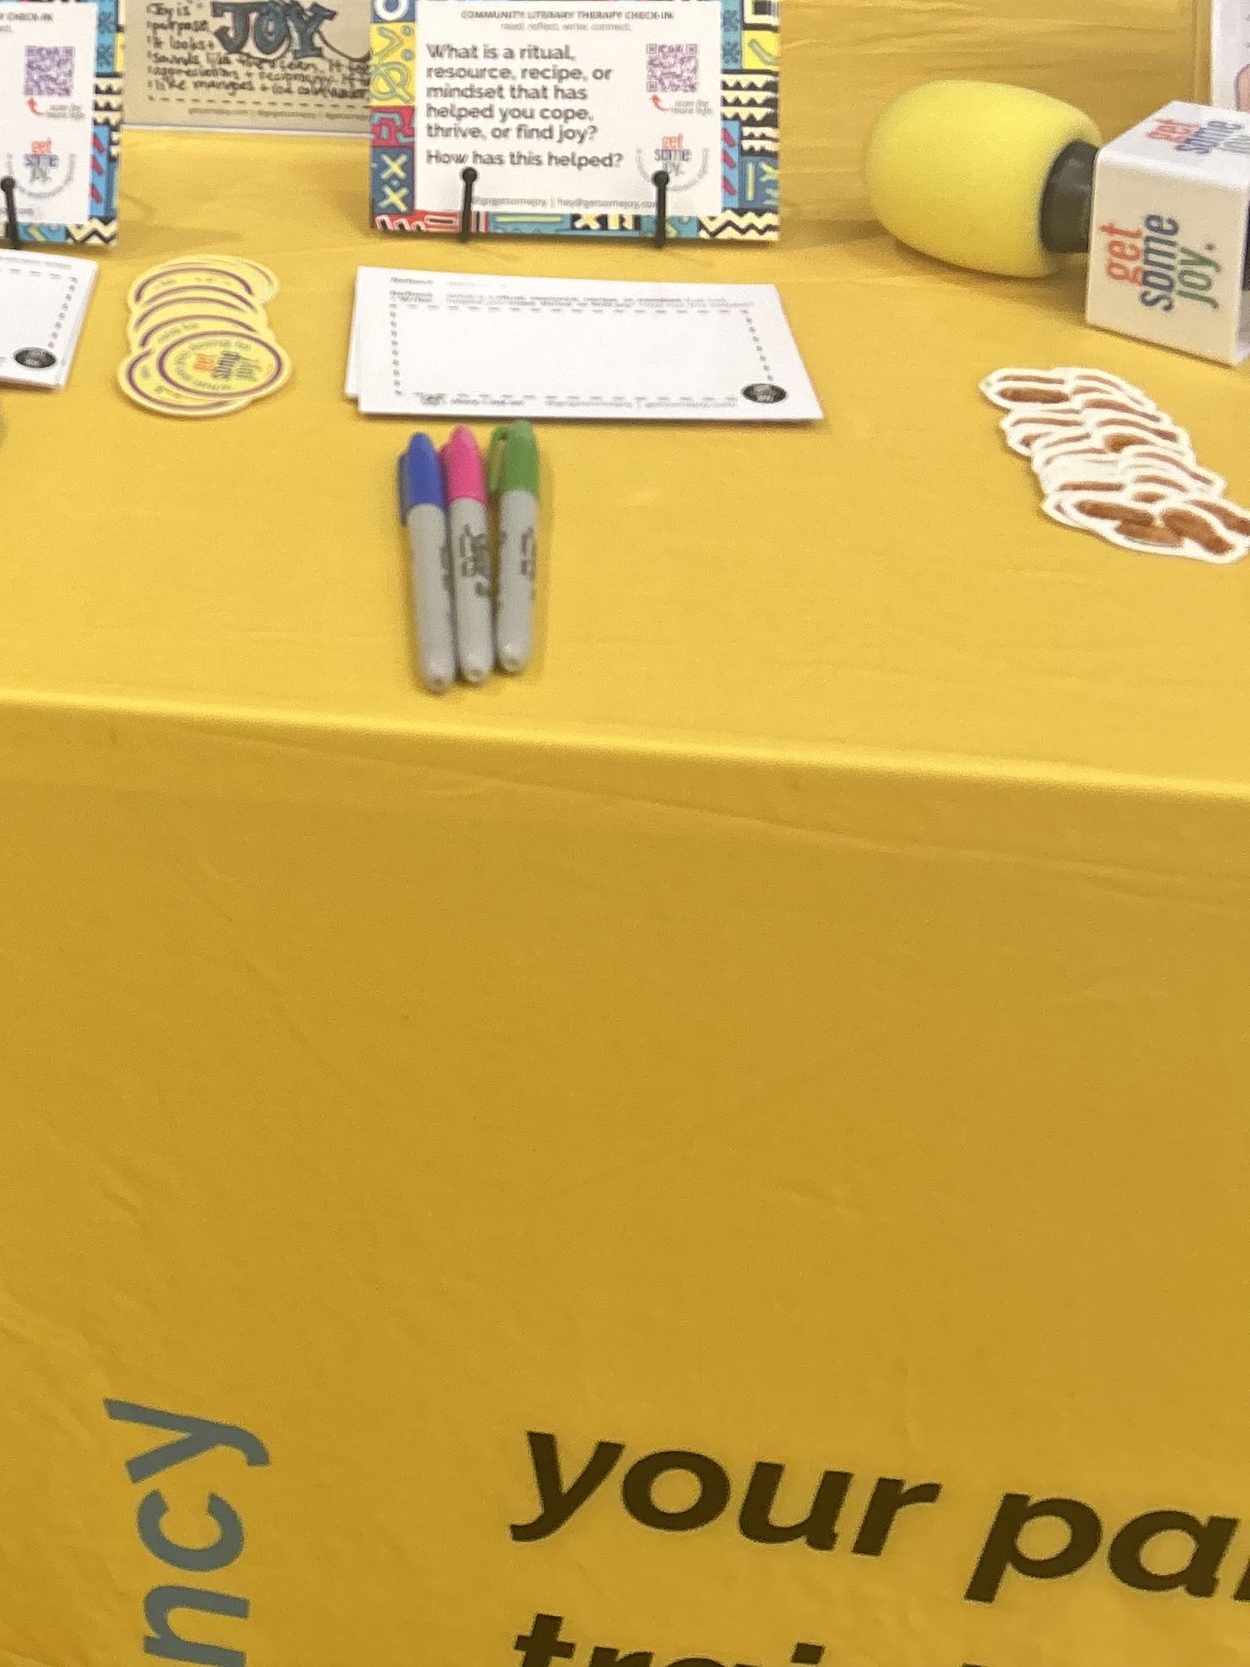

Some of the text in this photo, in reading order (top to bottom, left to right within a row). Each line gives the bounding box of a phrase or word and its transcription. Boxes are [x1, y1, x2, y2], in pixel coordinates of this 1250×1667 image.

[426, 43, 576, 61] What is a ritual,
[426, 65, 614, 84] resource, recipe, or
[426, 85, 589, 100] mindset that has
[426, 103, 594, 123] helped you cope,
[426, 124, 598, 143] thrive, or find joy?
[426, 150, 624, 170] How has this helped?
[1100, 221, 1144, 287] get
[1140, 213, 1180, 312] some
[1176, 242, 1221, 310] joy.
[510, 1428, 1250, 1604] your pa
[103, 1396, 271, 1667] ncy
